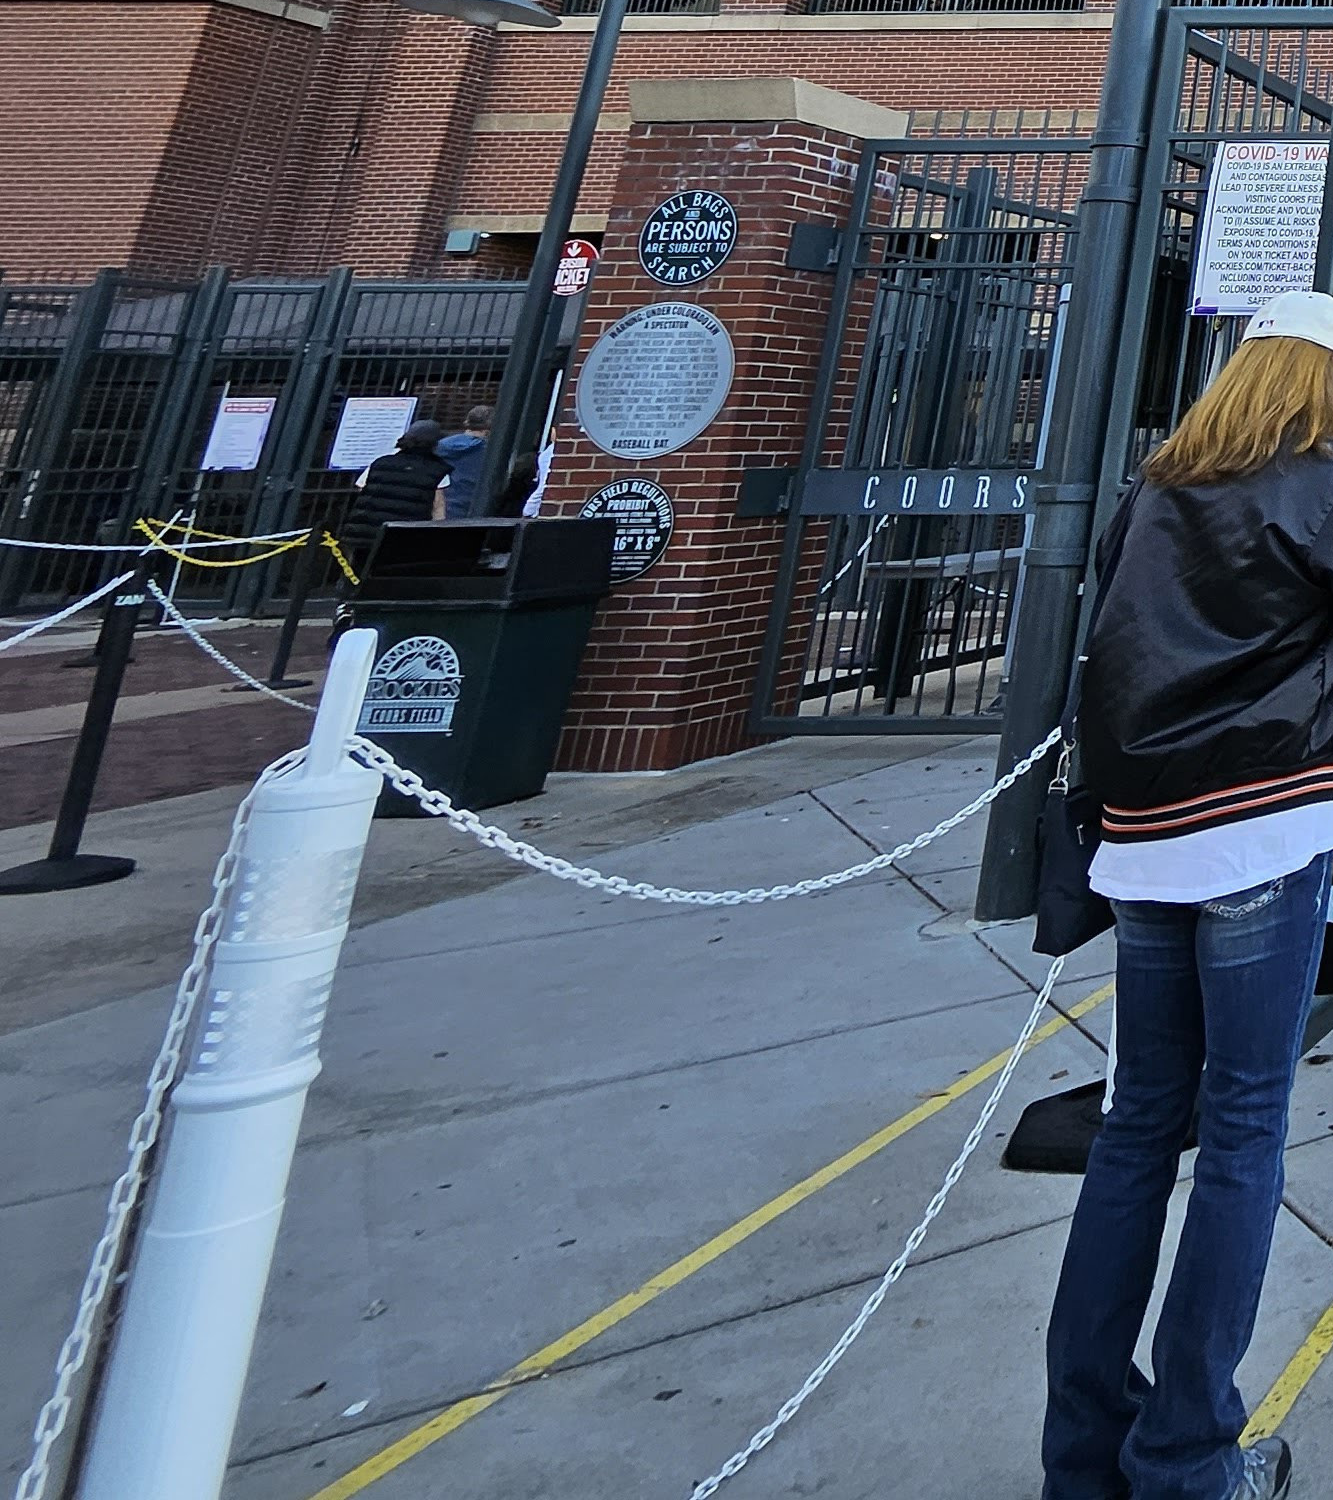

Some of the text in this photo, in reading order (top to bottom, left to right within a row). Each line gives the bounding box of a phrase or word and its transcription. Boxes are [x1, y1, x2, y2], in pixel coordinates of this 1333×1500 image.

[1226, 145, 1300, 161] COVID-19
[1227, 161, 1261, 170] COVID-19
[1262, 162, 1270, 170] IS
[1271, 162, 1282, 170] AN
[1230, 172, 1327, 182] AND CONTAGIOUS DISEAS
[1220, 183, 1241, 192] LEAD
[1243, 183, 1253, 192] TO
[1254, 183, 1286, 192] SEVERE
[1286, 184, 1318, 193] ILLNESS
[1245, 194, 1324, 204] VISITING COORS FIEL
[661, 192, 729, 219] ALL BAGS
[1215, 205, 1277, 215] ACKNOWLEDGE
[1276, 206, 1294, 215] AND
[1223, 216, 1233, 225] TO
[1243, 216, 1276, 226] ASSUME
[1276, 217, 1291, 226] ALL
[1292, 217, 1317, 226] RISKS
[647, 220, 733, 241] PERSONS
[1223, 227, 1266, 237] EXPOSURE
[1267, 228, 1278, 237] TO
[644, 242, 728, 253] ARE SUBJECT TO
[1217, 239, 1243, 248] TERMS
[1243, 239, 1261, 248] AND
[1262, 239, 1310, 249] CONDITIONS
[1227, 250, 1239, 259] ON
[1240, 250, 1263, 259] YOUR
[1264, 251, 1291, 260] TICKET
[1292, 251, 1309, 260] AND
[647, 256, 715, 281] SEARCH
[554, 268, 591, 286] ICKET
[1220, 273, 1313, 283] INCLUDING COMPLIANCE
[1218, 284, 1262, 294] COLORADO
[1246, 296, 1274, 306] SAFET
[608, 305, 720, 340] WARNING: UNDER COLORADO LAW
[643, 320, 690, 330] A SPECTATOR
[611, 439, 650, 450] BASEBALL
[863, 475, 1029, 509] COORS
[600, 482, 629, 501] FIELD
[630, 481, 671, 530] REGULATIONS
[606, 499, 650, 511] PROHIBIT
[634, 536, 645, 551] X
[364, 678, 462, 699] ROCKIES
[371, 708, 443, 723] COORS FIELD
